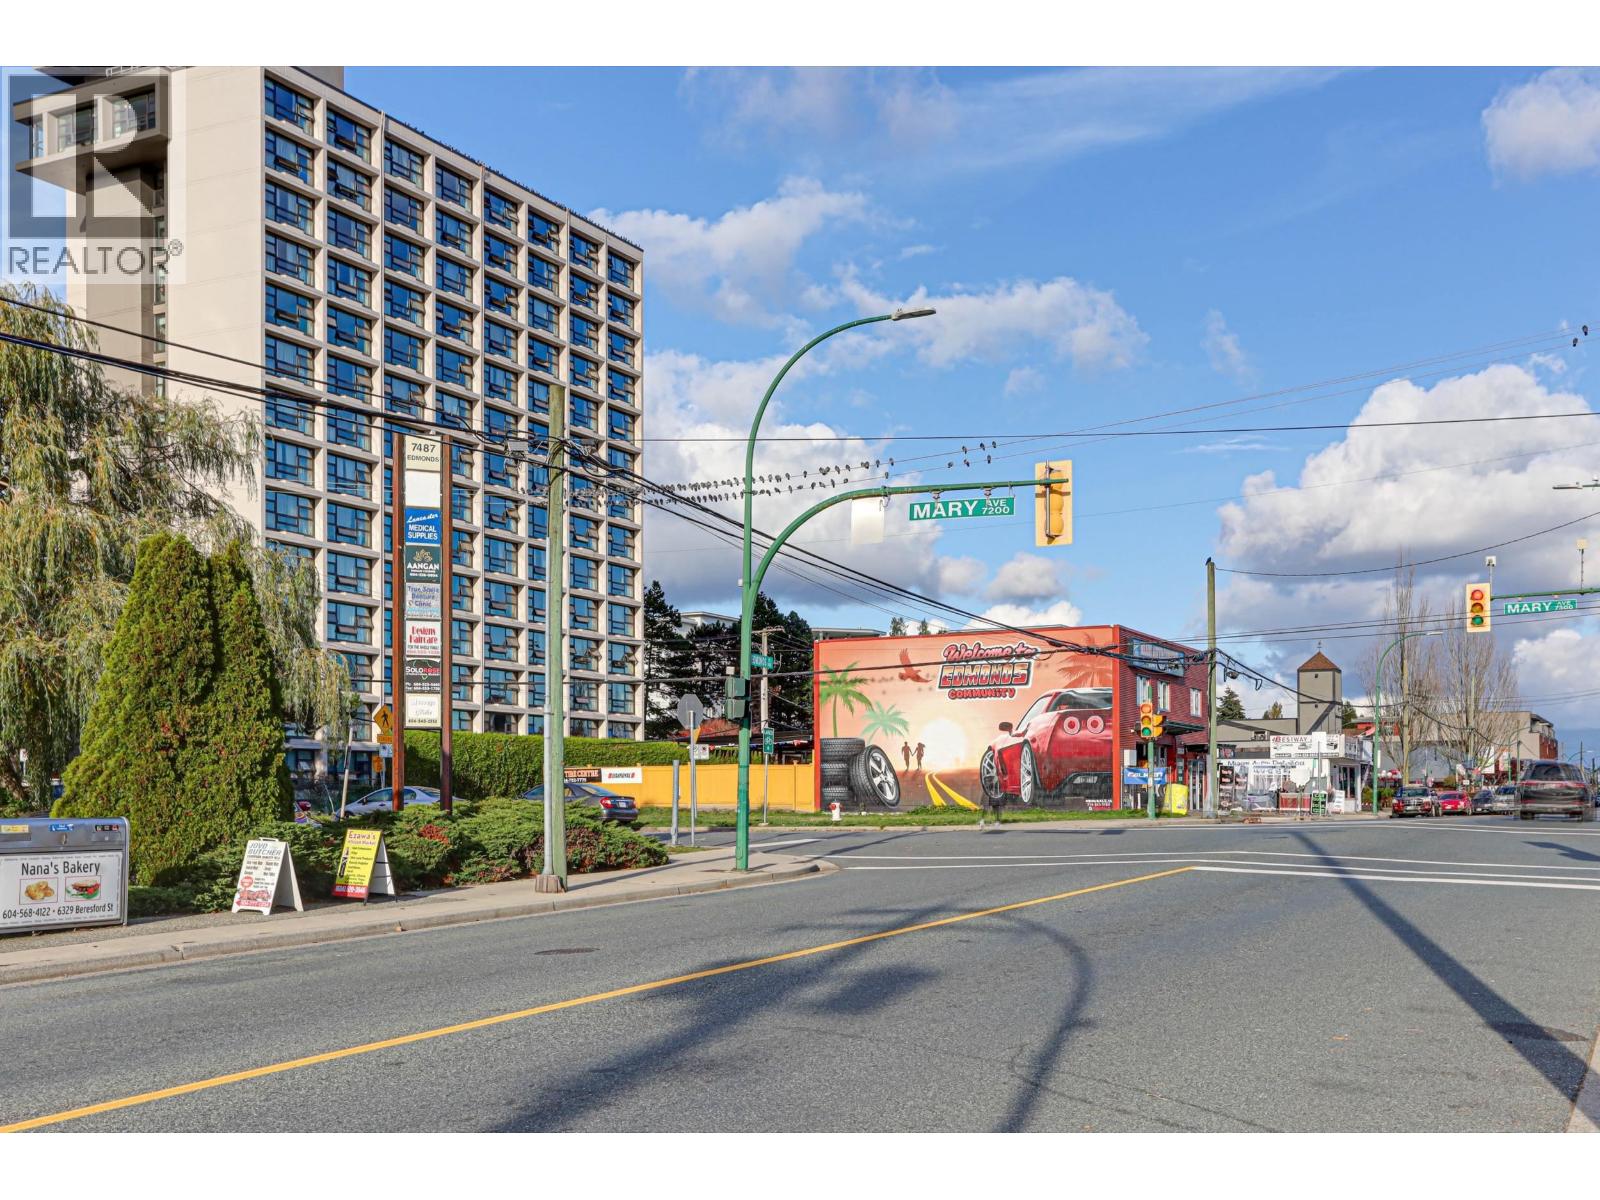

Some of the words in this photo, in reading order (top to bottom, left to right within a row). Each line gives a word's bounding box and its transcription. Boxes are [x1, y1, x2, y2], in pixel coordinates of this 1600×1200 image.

[411, 442, 436, 452] 7487
[407, 454, 440, 462] EDMONDS
[913, 500, 978, 519] MARY
[987, 499, 1007, 507] AVE
[982, 506, 1010, 515] 7200
[408, 524, 437, 532] MEDICAL
[407, 531, 438, 540] SUPPLIES
[406, 561, 440, 570] AANGAN
[1507, 602, 1551, 613] MARY
[943, 642, 1013, 663] Welcome
[940, 663, 1031, 687] EDMONDS
[948, 688, 1016, 699] COMMUNITY
[21, 863, 59, 876] Nana's
[63, 861, 101, 874] Bakery
[2, 907, 51, 919] 604-568-4122
[57, 905, 74, 915] 6329
[75, 903, 107, 914] Beresford
[107, 902, 114, 912] St
